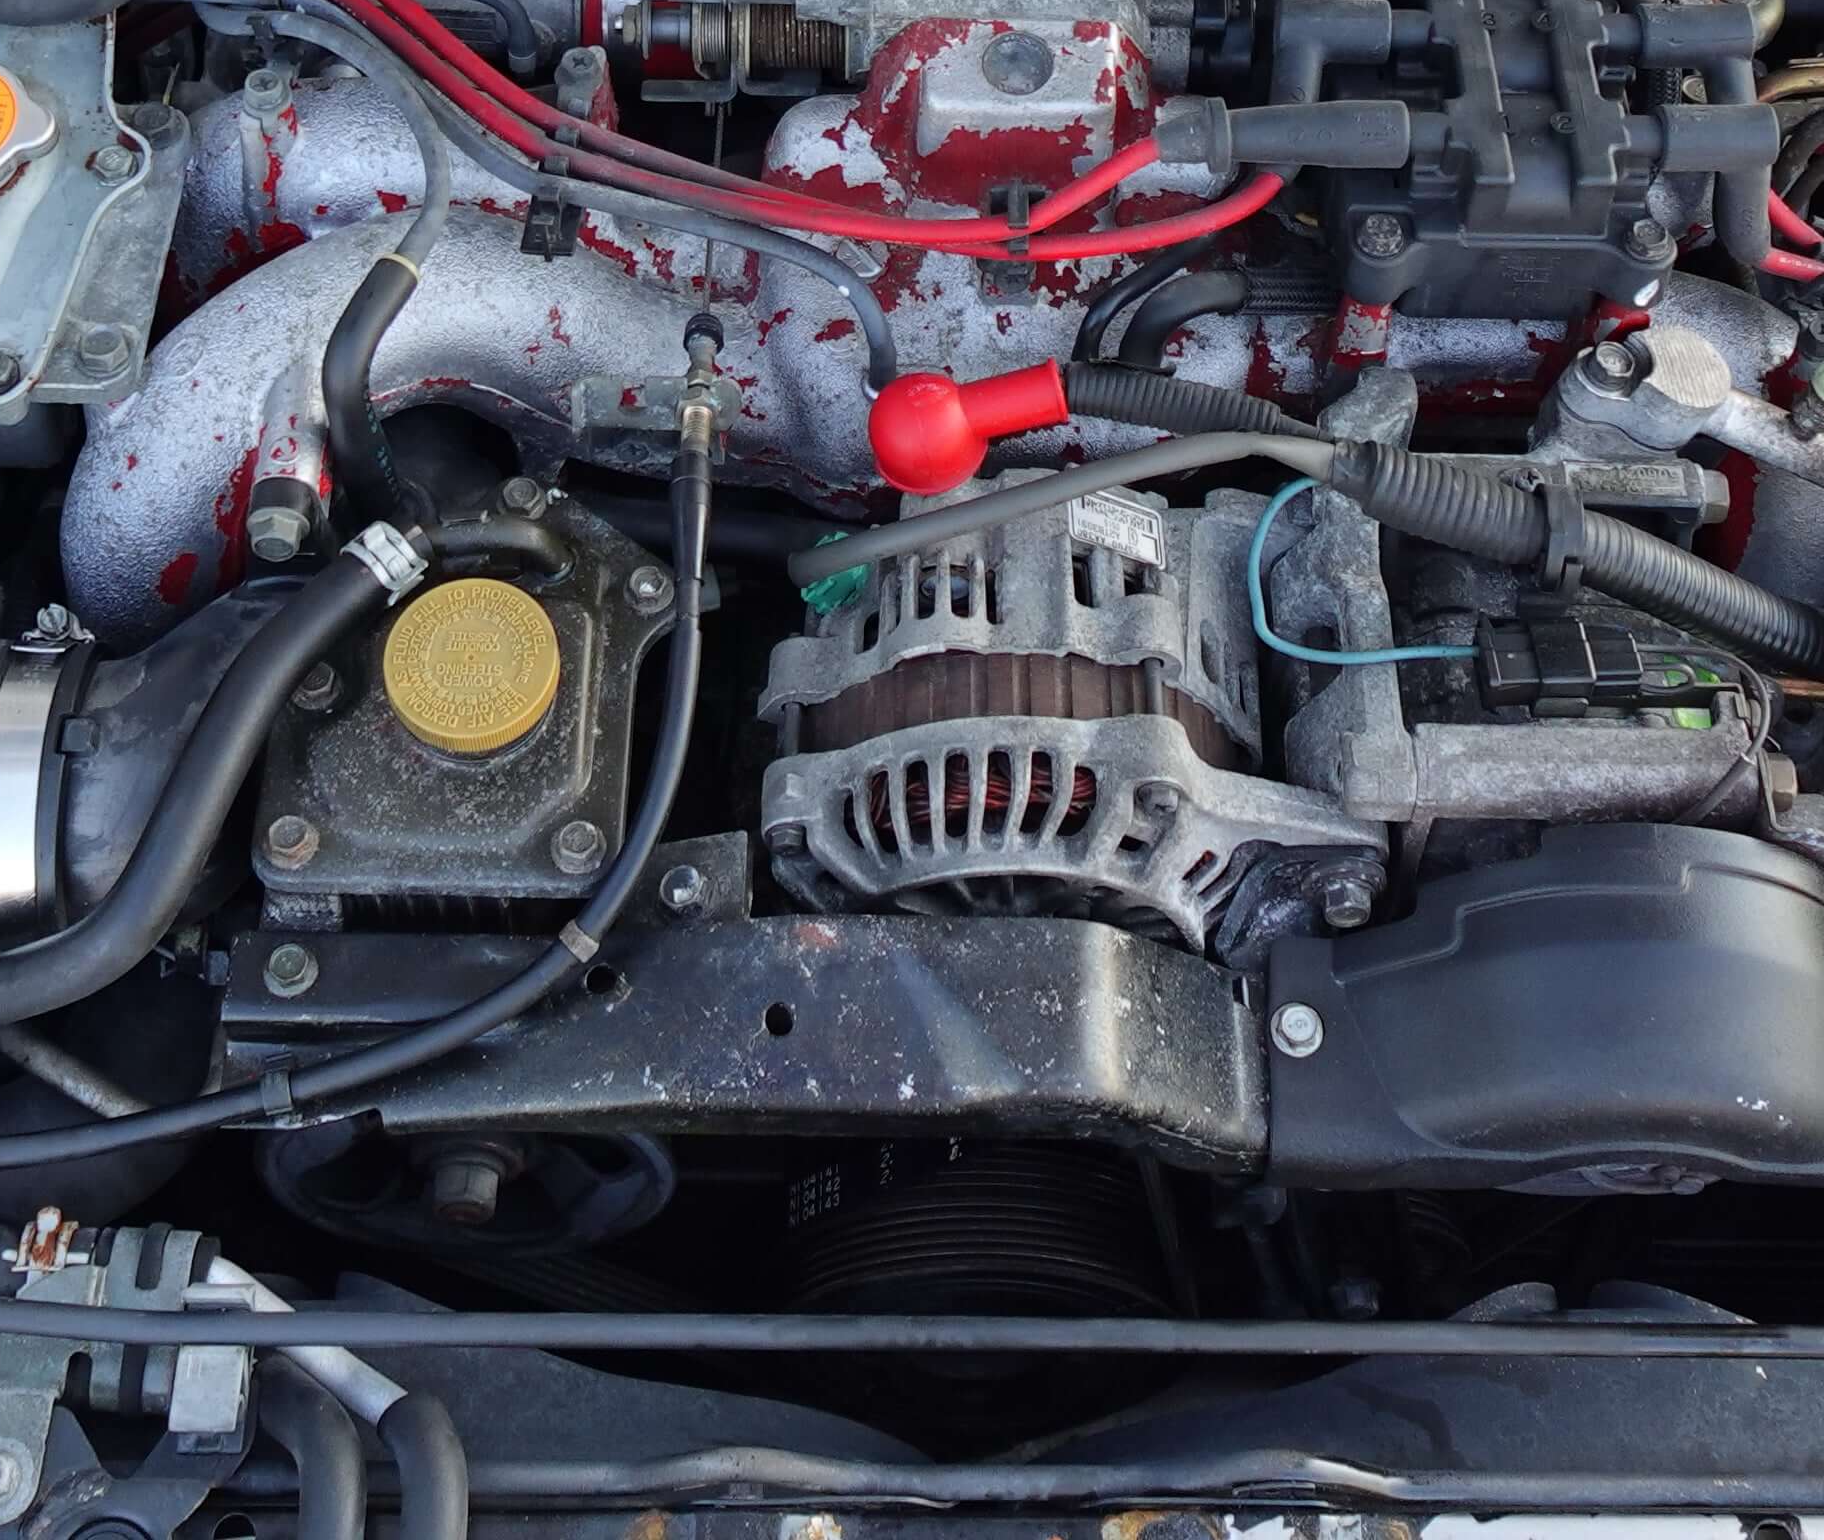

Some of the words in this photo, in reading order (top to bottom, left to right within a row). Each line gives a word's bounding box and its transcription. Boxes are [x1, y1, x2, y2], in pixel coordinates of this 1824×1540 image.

[446, 586, 466, 603] TO
[471, 585, 528, 614] PROPER
[412, 600, 442, 623] FILL
[524, 611, 548, 655] LEVEL
[392, 624, 415, 665] FLUID
[445, 640, 502, 653] CONDUITE
[435, 663, 506, 677] STEERING
[443, 673, 494, 688] POWER
[405, 689, 460, 729] DEXRON
[465, 709, 497, 729] ATF
